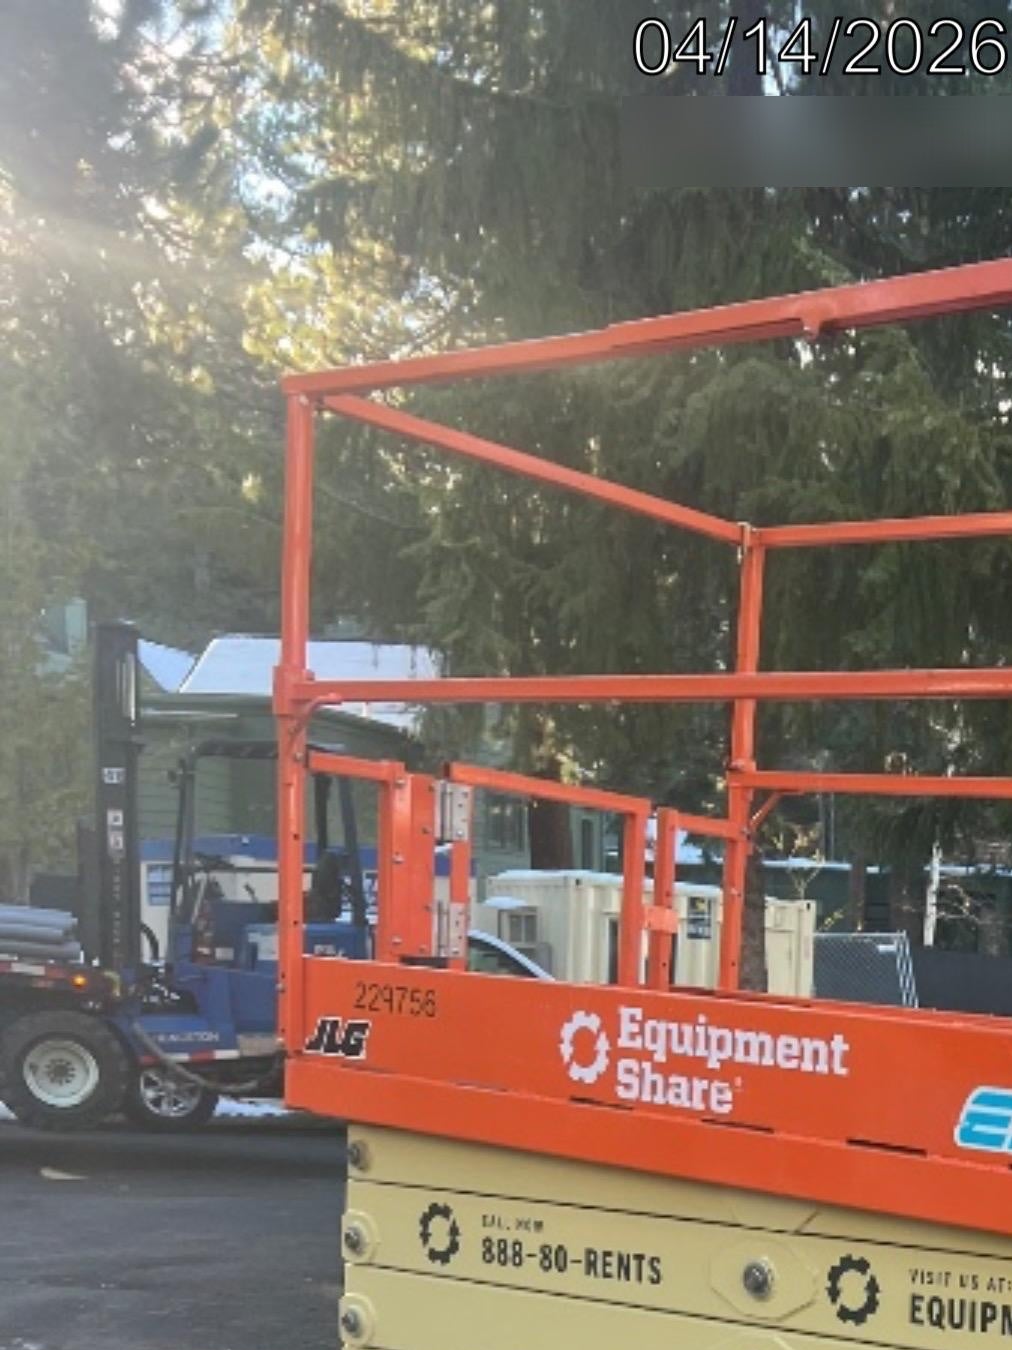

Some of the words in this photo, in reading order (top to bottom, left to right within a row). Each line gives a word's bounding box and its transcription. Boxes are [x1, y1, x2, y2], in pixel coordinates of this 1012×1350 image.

[304, 1016, 370, 1059] JLG
[616, 1005, 850, 1076] Equipment
[616, 1058, 733, 1115] Share
[481, 1236, 662, 1285] 888-80-RENTS
[908, 1268, 952, 1288] VISIT
[959, 1273, 979, 1291] US
[986, 1276, 1012, 1294] AT:
